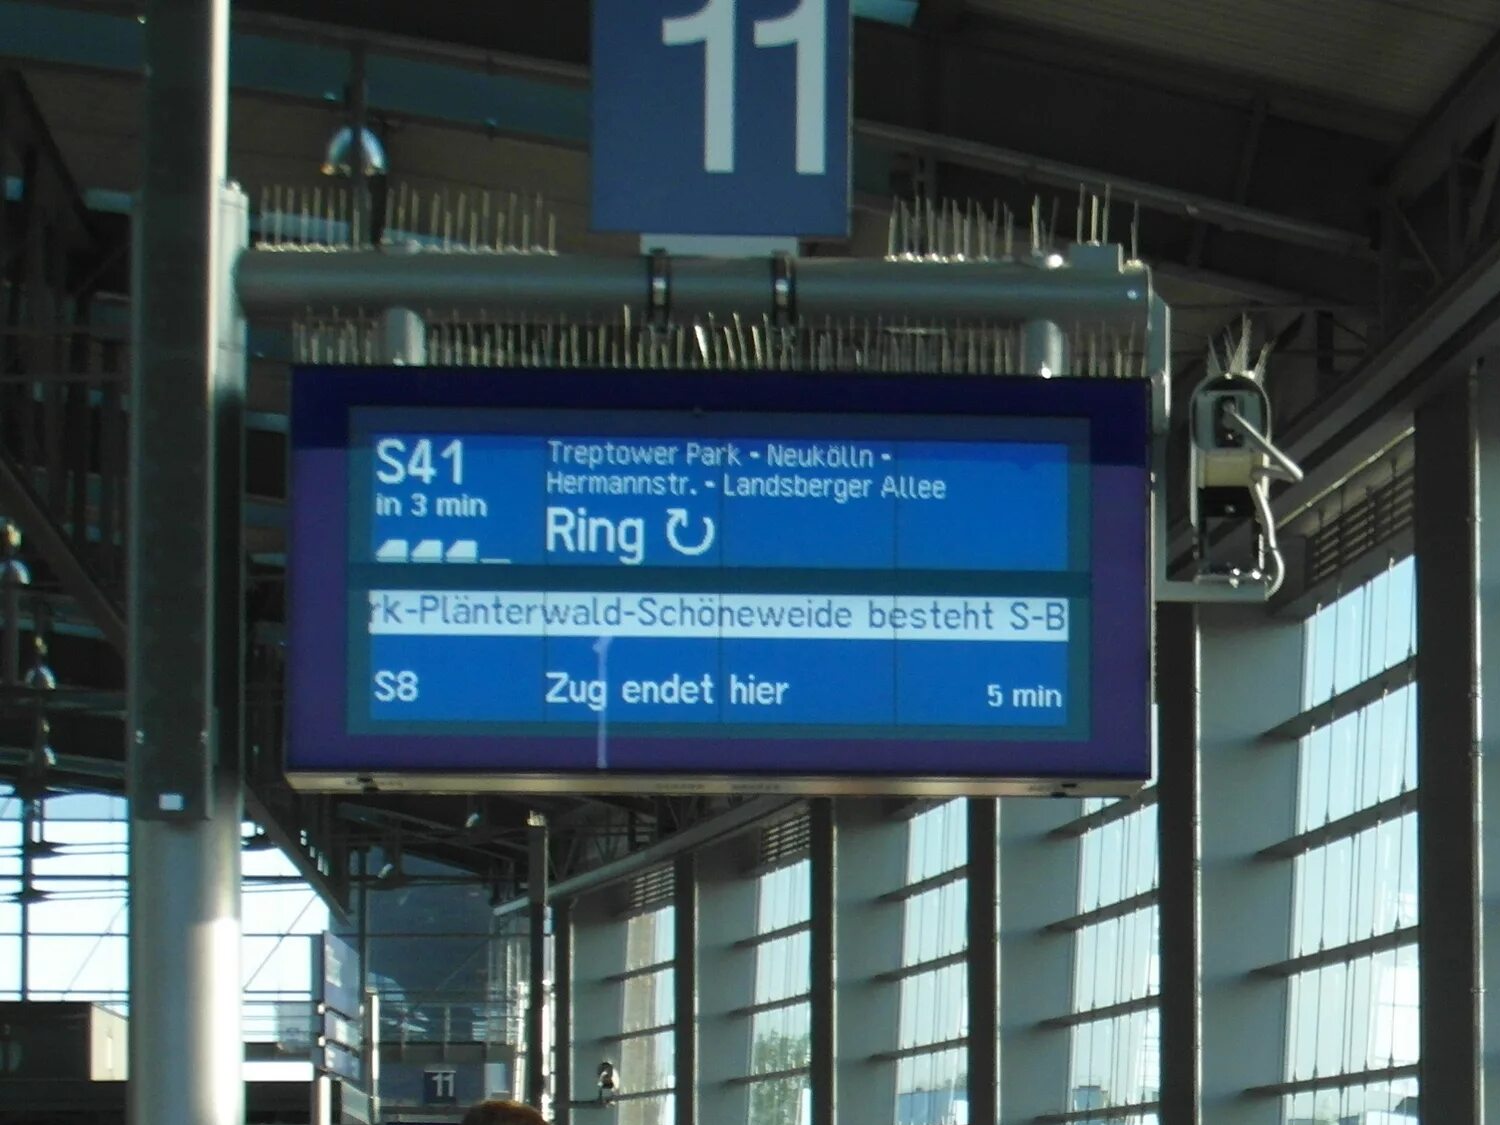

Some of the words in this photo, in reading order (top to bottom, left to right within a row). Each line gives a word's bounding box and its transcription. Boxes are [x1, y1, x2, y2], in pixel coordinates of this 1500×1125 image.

[662, 0, 826, 174] 11
[376, 439, 463, 485] S41
[547, 440, 679, 469] Treptower
[686, 442, 741, 467] Park
[767, 444, 874, 467] Neukölln
[546, 471, 697, 496] Hermannstr.
[723, 473, 873, 503] Landsberger
[881, 475, 947, 499] Allee
[375, 493, 401, 517] in
[411, 493, 428, 517] 3
[436, 494, 488, 517] min
[546, 506, 645, 565] Ring
[868, 599, 994, 630] besteht
[1009, 600, 1066, 632] S-B
[374, 670, 420, 702] S8
[545, 672, 607, 711] Zug
[621, 672, 714, 704] endet
[729, 673, 790, 705] hier
[986, 684, 1003, 708] 5
[1012, 685, 1063, 708] min
[431, 1073, 455, 1097] 11
